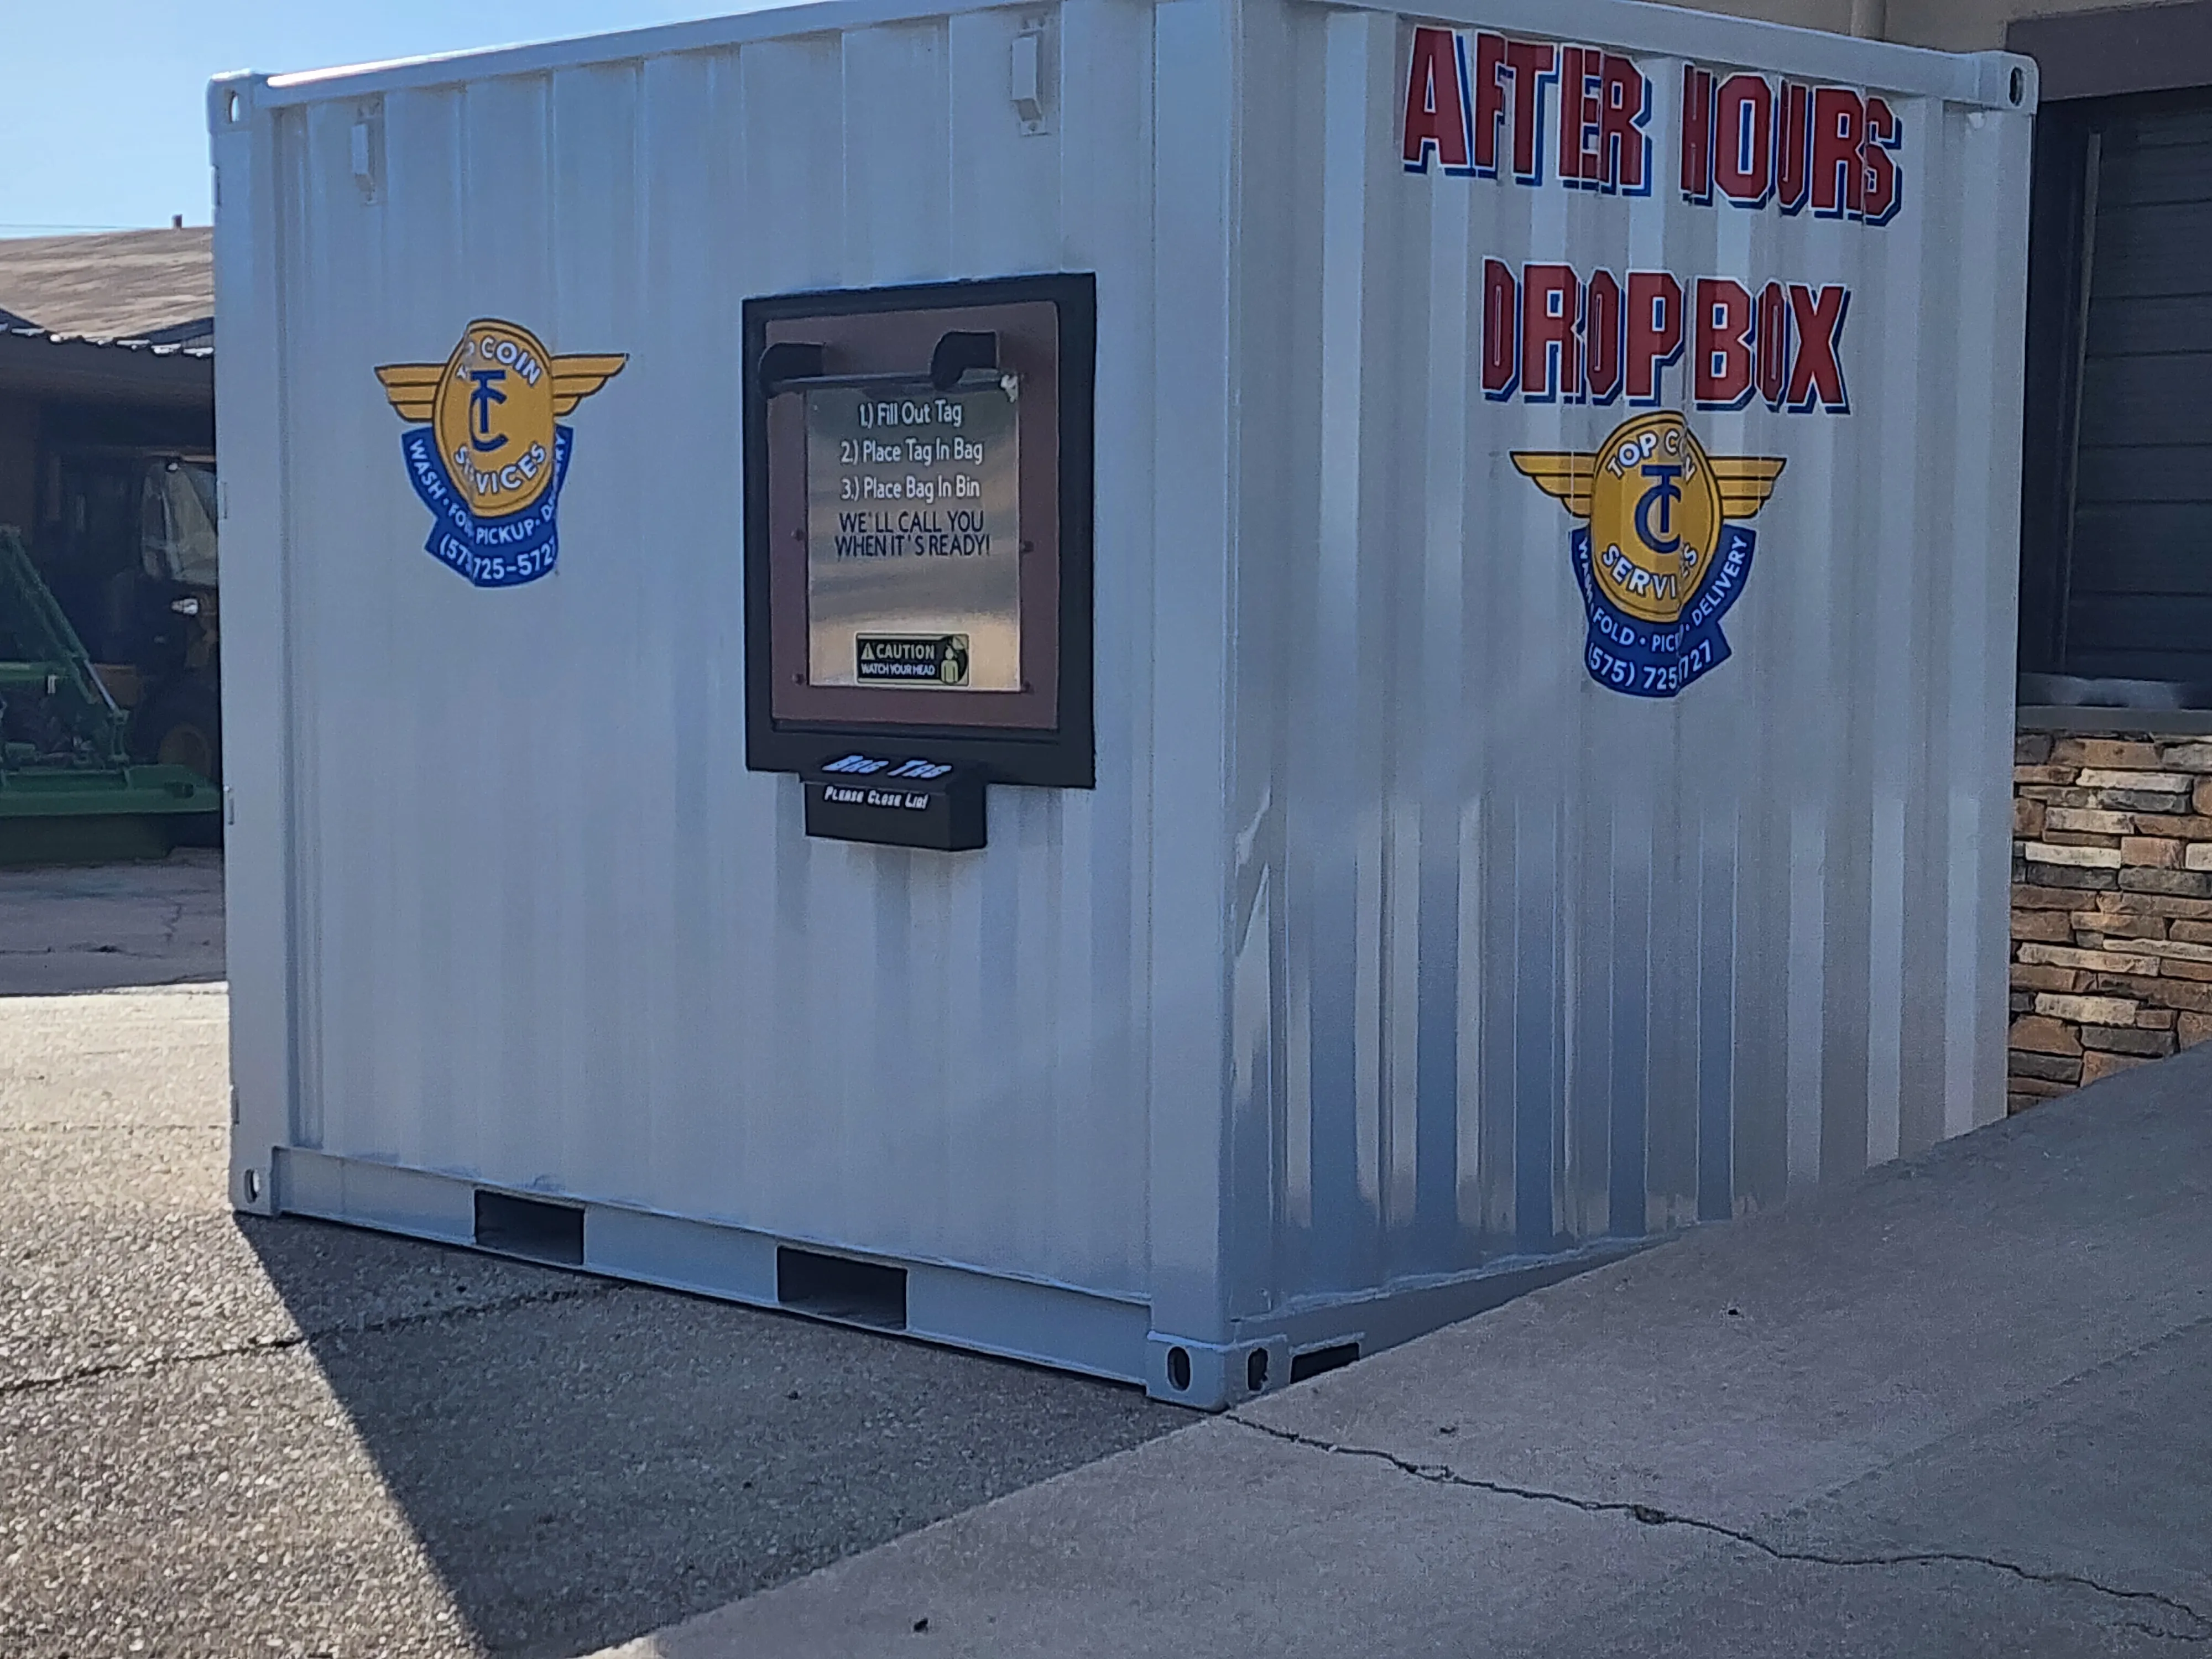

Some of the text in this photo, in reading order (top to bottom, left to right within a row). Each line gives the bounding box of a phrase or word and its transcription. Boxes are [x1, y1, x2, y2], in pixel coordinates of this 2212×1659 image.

[1402, 25, 1903, 227] AFTER HOURS
[480, 335, 541, 386] COIN
[877, 401, 899, 426] Fill
[901, 401, 931, 425] Out
[935, 398, 962, 427] Tag
[840, 437, 983, 467] 2.) Place Tag In Bag
[1606, 430, 1658, 479] TOP
[409, 437, 448, 500] WASH
[475, 518, 535, 545] PICKUP
[841, 474, 980, 504] 3.) Place Bag In Bin
[839, 510, 984, 533] WE'LL CALL YOU
[834, 534, 990, 558] WHEN IT'S READY!
[1592, 607, 1636, 646] FOLD
[1692, 535, 1748, 627] DELIVERY
[876, 644, 935, 660] CAUTION
[860, 662, 936, 676] WATCH YOUR HEAD
